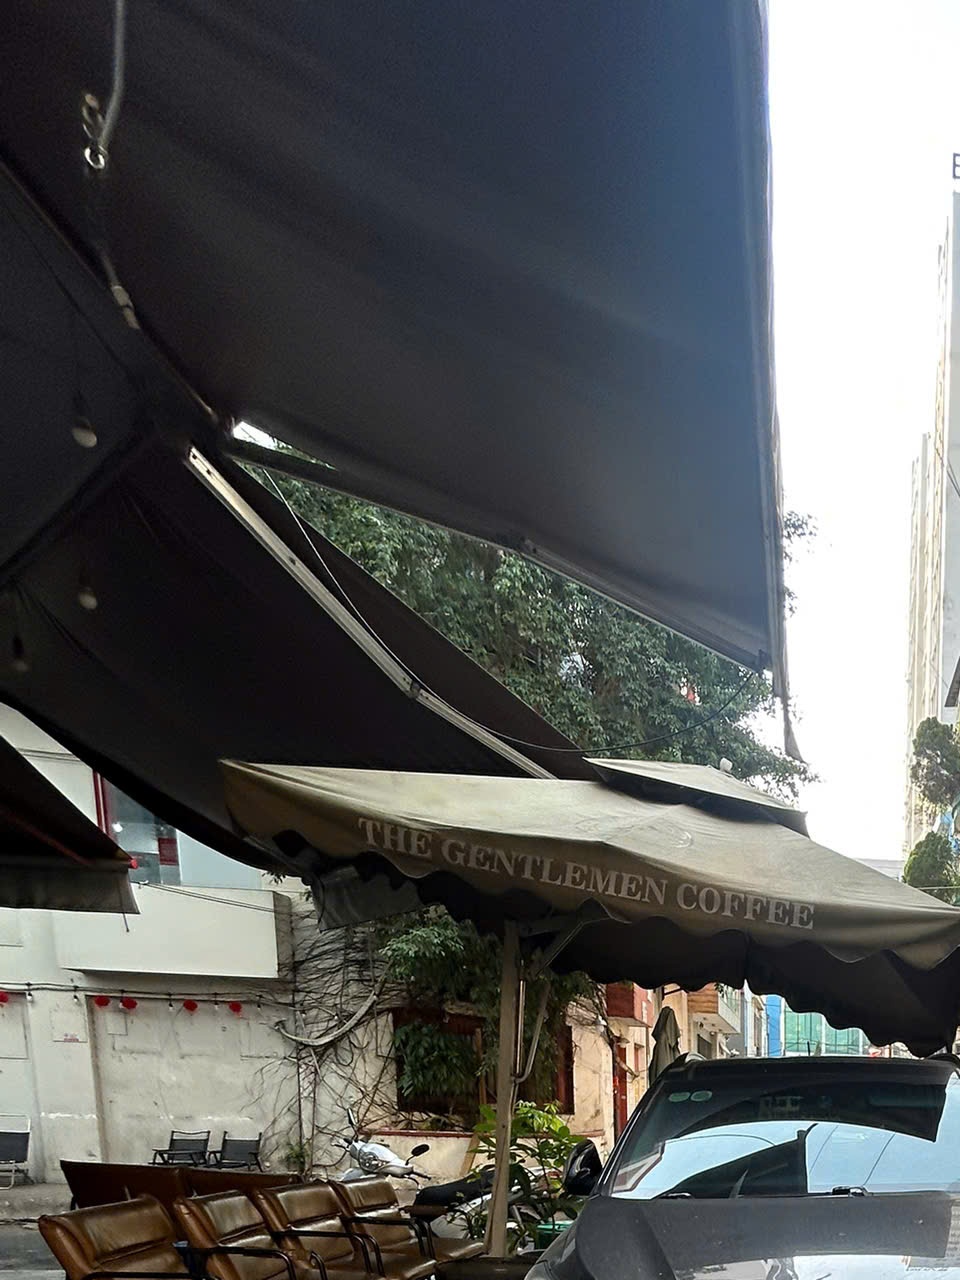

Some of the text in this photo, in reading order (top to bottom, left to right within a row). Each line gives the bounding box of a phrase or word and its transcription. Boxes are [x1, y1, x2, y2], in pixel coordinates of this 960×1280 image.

[358, 817, 815, 930] THE GENTLEMEN COFFEE
